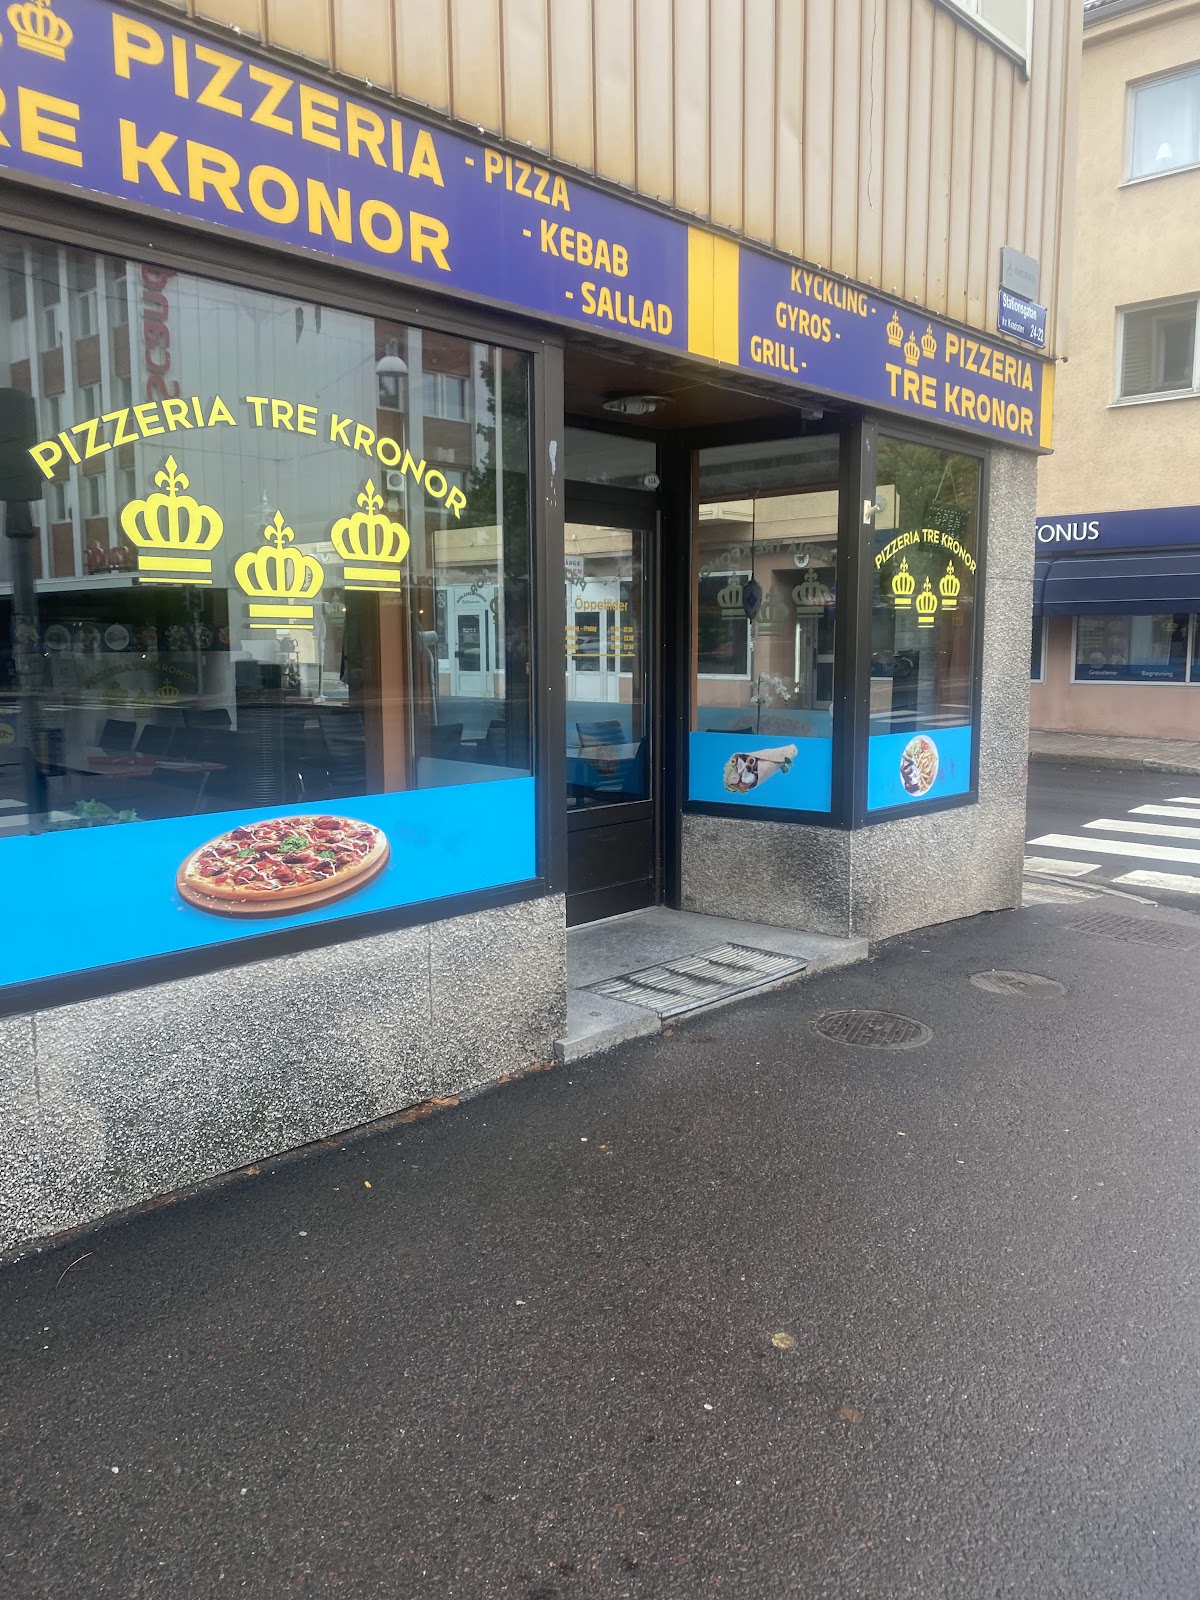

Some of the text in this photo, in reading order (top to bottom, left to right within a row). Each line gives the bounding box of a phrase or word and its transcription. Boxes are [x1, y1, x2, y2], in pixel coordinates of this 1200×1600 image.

[112, 12, 445, 188] PIZZERIA
[0, 85, 452, 272] E KRONOR
[484, 147, 571, 212] PIZZA
[540, 218, 629, 277] KEBAB
[581, 281, 674, 336] SALLAD
[790, 265, 868, 318] KYCKLING
[1002, 293, 1037, 320] Stationsgatan
[775, 301, 832, 343] GYROS
[1029, 323, 1044, 342] 24-22
[750, 335, 799, 374] GRILL
[945, 331, 1034, 392] PIZZERIA
[885, 362, 1035, 437] TRE KRONOR
[28, 395, 468, 519] PIZZERIA TRE KRONOR
[874, 530, 921, 570] PIZZERIA
[922, 528, 940, 544] TRE
[940, 532, 977, 575] KRONOR
[1034, 521, 1101, 543] ONUS
